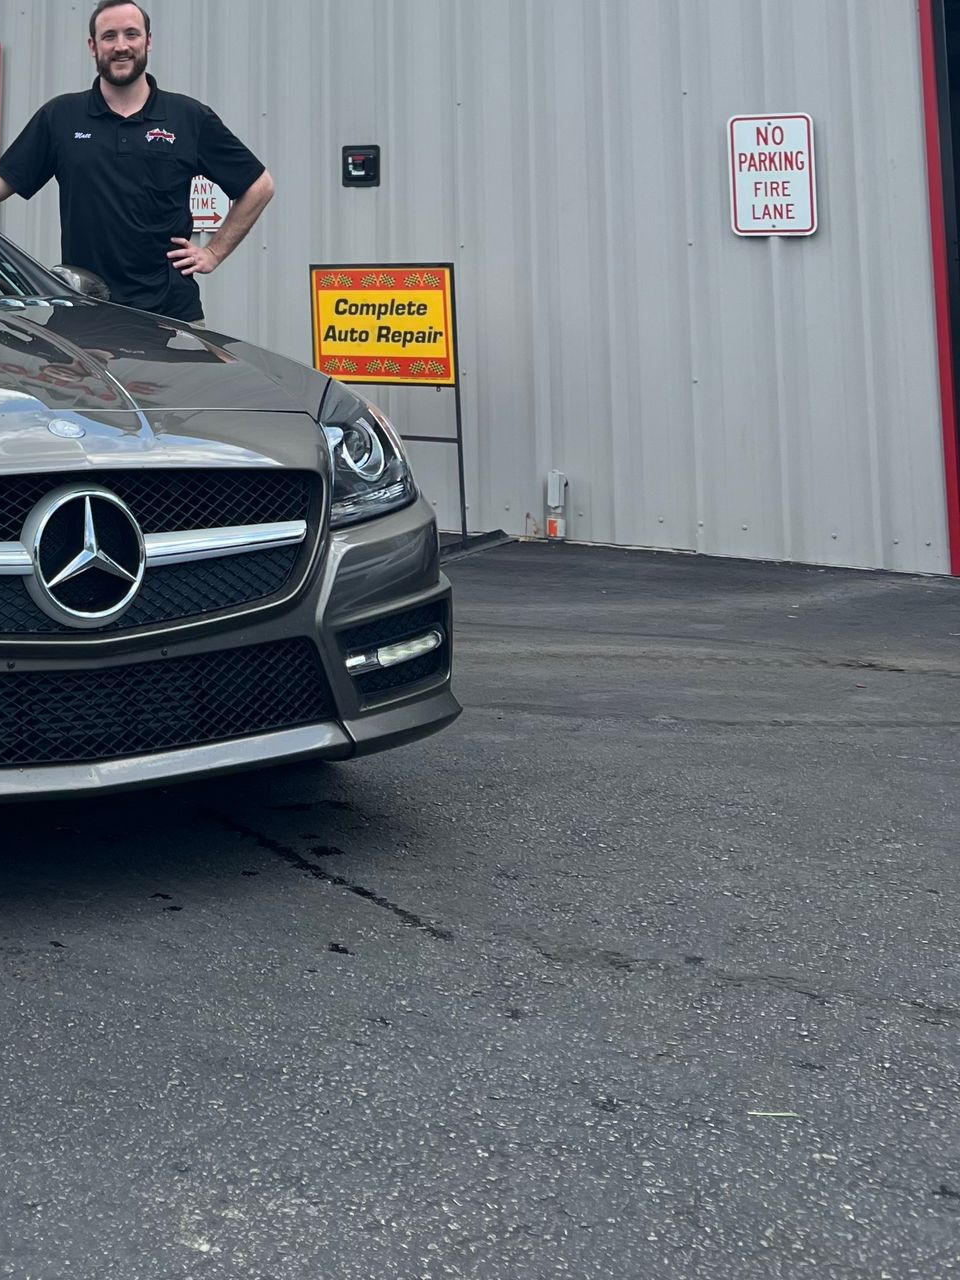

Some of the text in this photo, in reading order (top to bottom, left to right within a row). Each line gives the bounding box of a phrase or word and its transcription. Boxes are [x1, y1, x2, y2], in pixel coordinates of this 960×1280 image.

[756, 126, 784, 146] NO
[738, 151, 805, 172] PARKING
[193, 183, 214, 195] ANY
[754, 181, 791, 197] FIRE
[191, 197, 216, 210] TIME
[752, 204, 795, 220] LANE
[334, 298, 427, 320] Complete
[323, 325, 444, 348] Auto Repair
